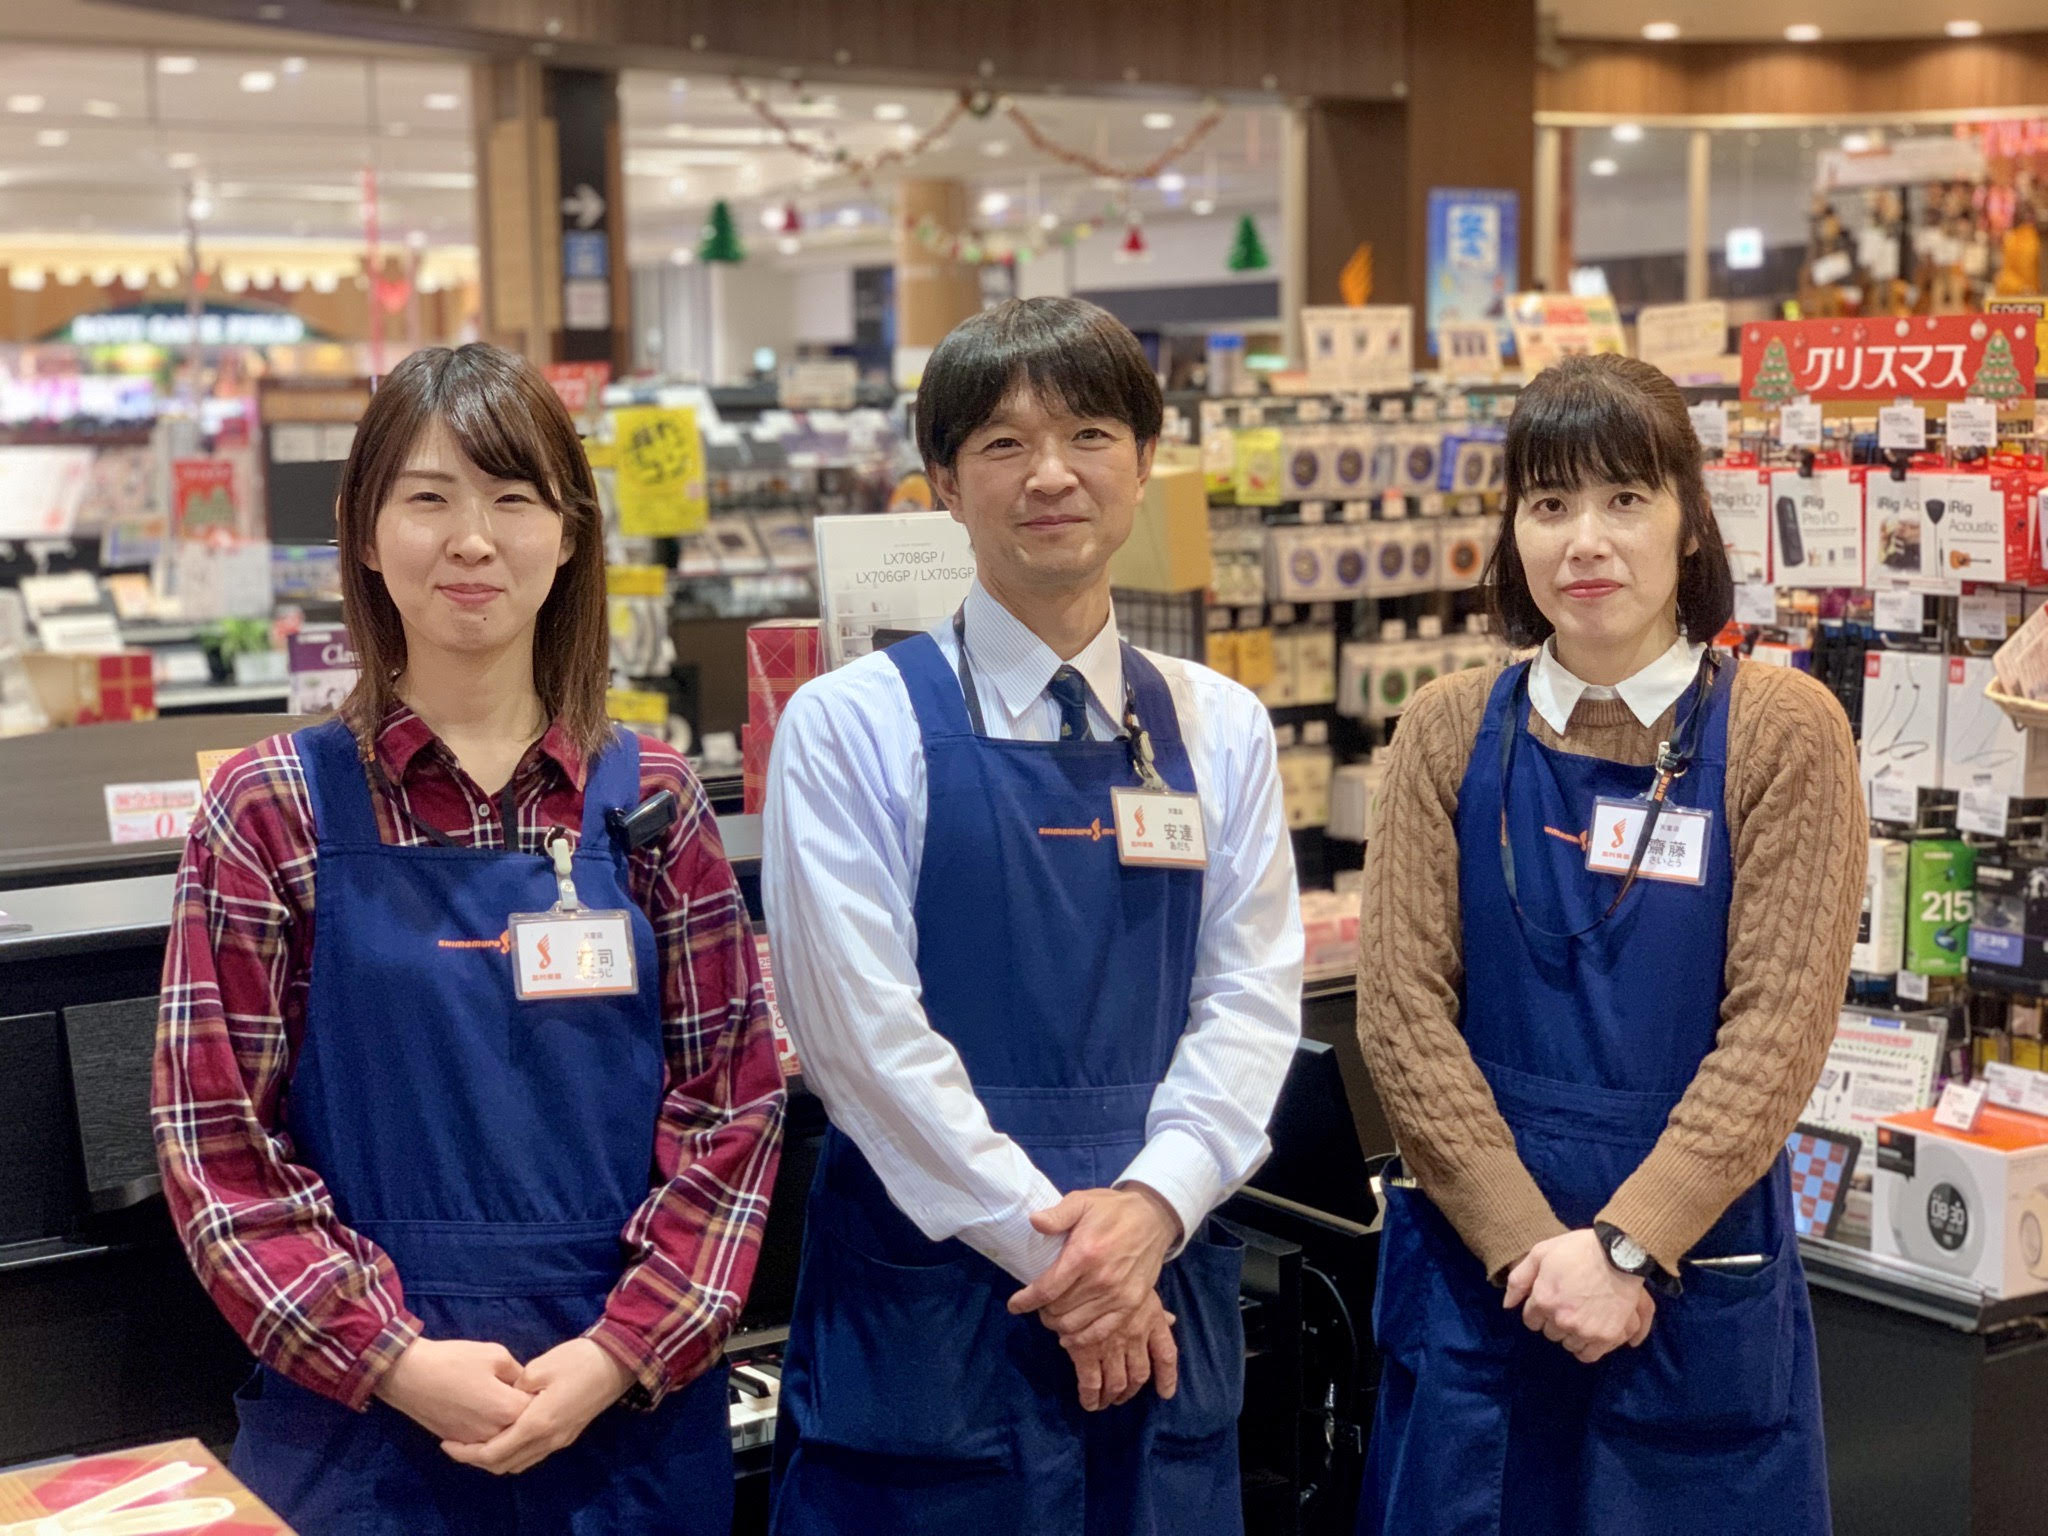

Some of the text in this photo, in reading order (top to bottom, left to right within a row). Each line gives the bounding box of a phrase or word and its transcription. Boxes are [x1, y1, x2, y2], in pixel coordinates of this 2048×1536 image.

[1801, 344, 1968, 392] クリスマス
[1949, 500, 1973, 517] iRig
[1949, 519, 1999, 535] Acoustic
[883, 551, 938, 566] LX708GP
[855, 569, 911, 584] LX706GP
[920, 566, 975, 582] LX705GP
[1163, 822, 1193, 842] 安達
[1920, 890, 1974, 923] 215
